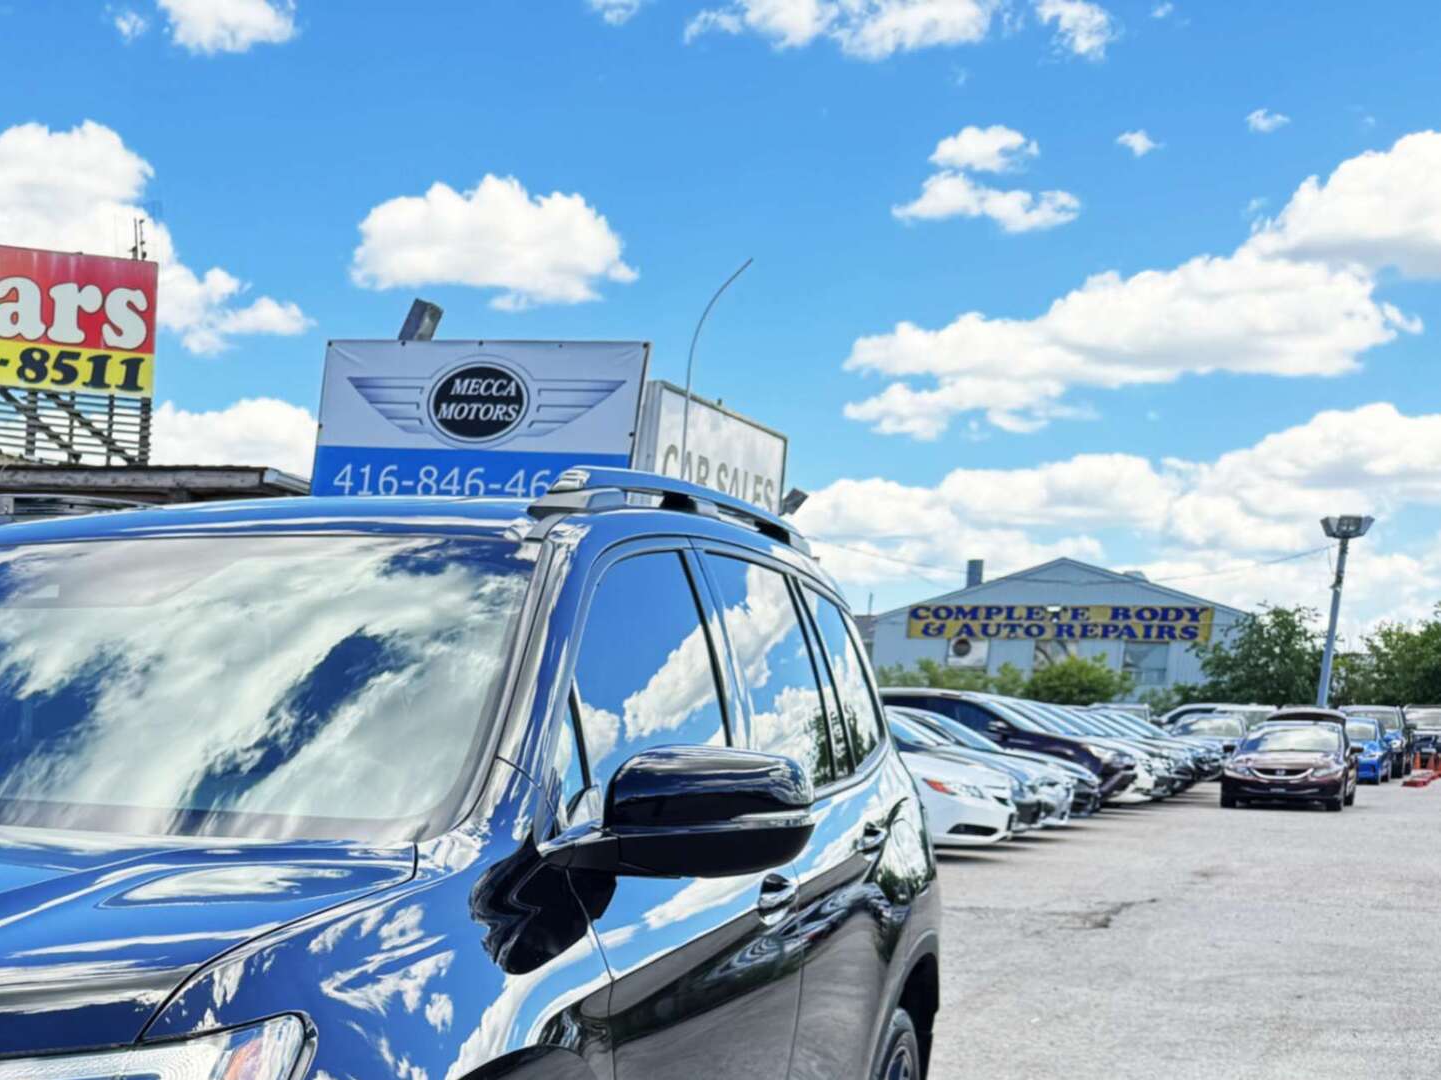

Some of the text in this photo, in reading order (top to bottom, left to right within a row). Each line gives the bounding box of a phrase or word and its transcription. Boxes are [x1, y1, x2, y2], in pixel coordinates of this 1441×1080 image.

[450, 378, 517, 396] MECCA
[437, 402, 519, 421] MOTORS
[333, 463, 552, 497] 416-846-46
[1111, 606, 1209, 622] BODY
[922, 622, 1199, 640] & AUTO REPAIRS
